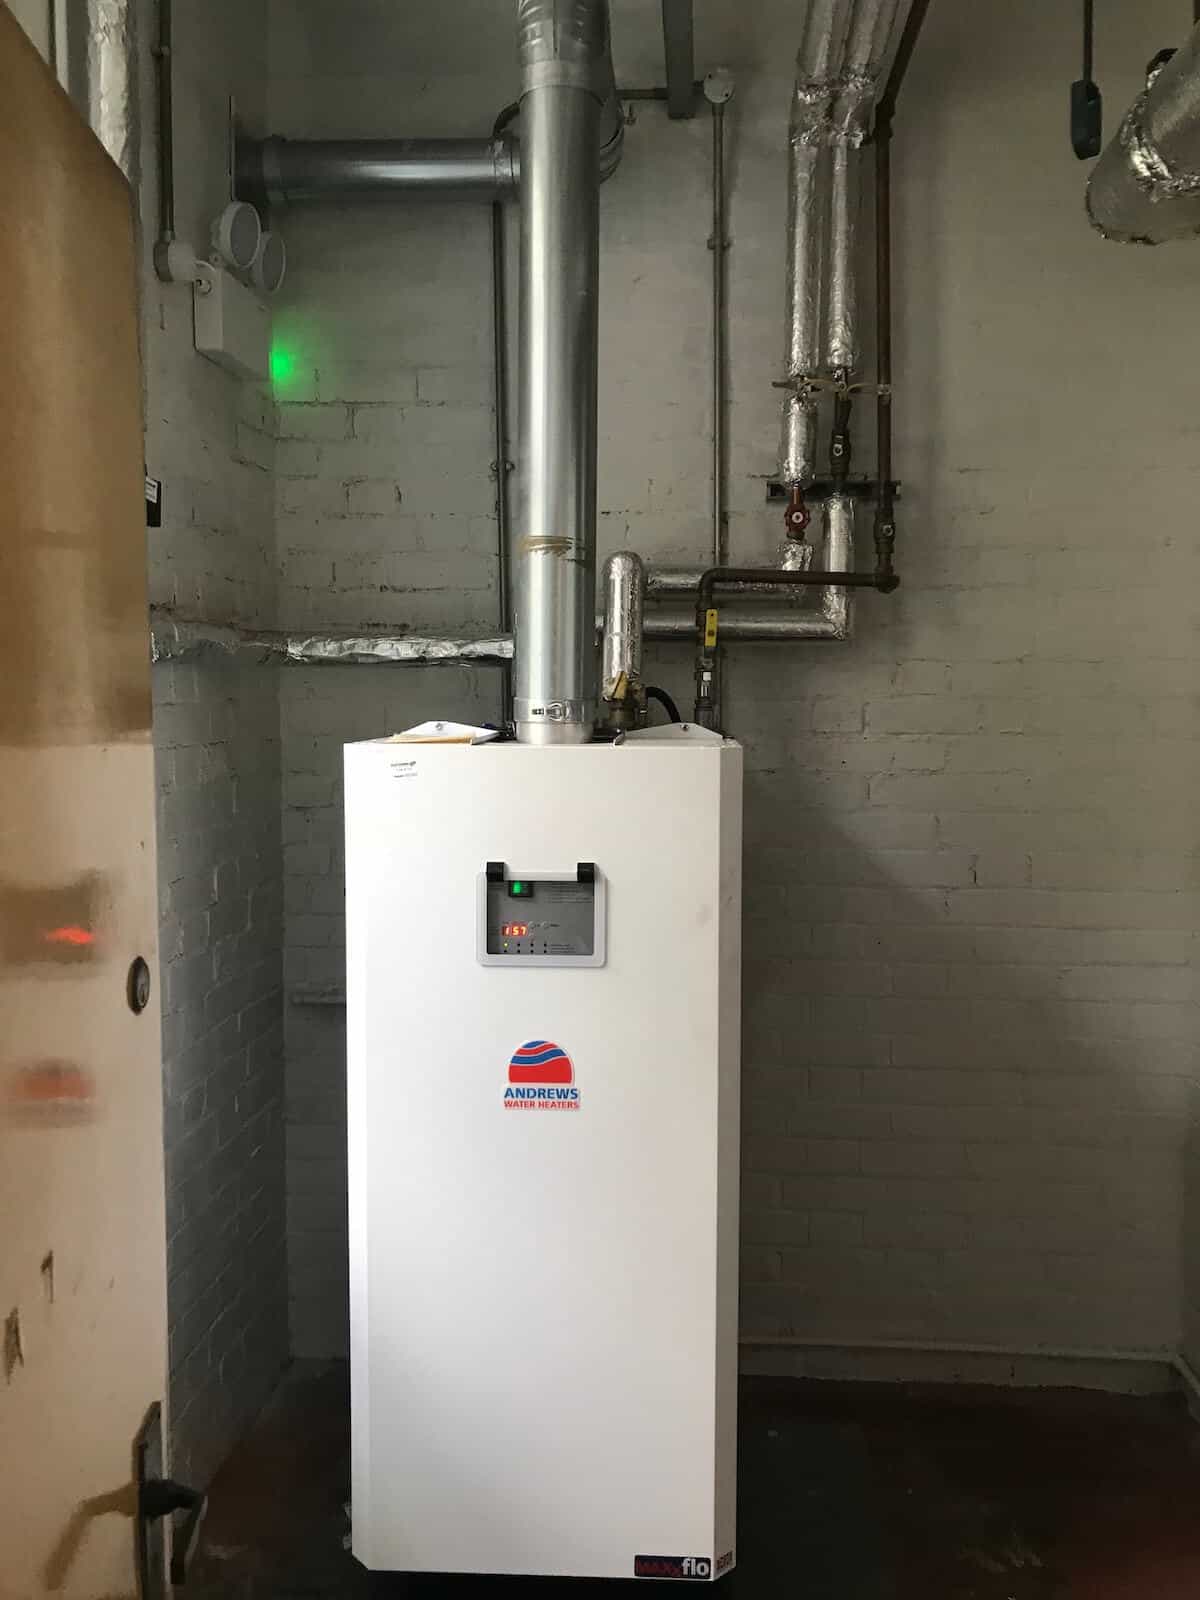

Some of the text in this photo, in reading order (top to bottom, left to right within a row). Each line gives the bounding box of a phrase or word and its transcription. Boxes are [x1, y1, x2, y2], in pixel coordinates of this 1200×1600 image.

[503, 1087, 579, 1100] ANDREWS
[503, 1100, 579, 1110] WATER HEATERS
